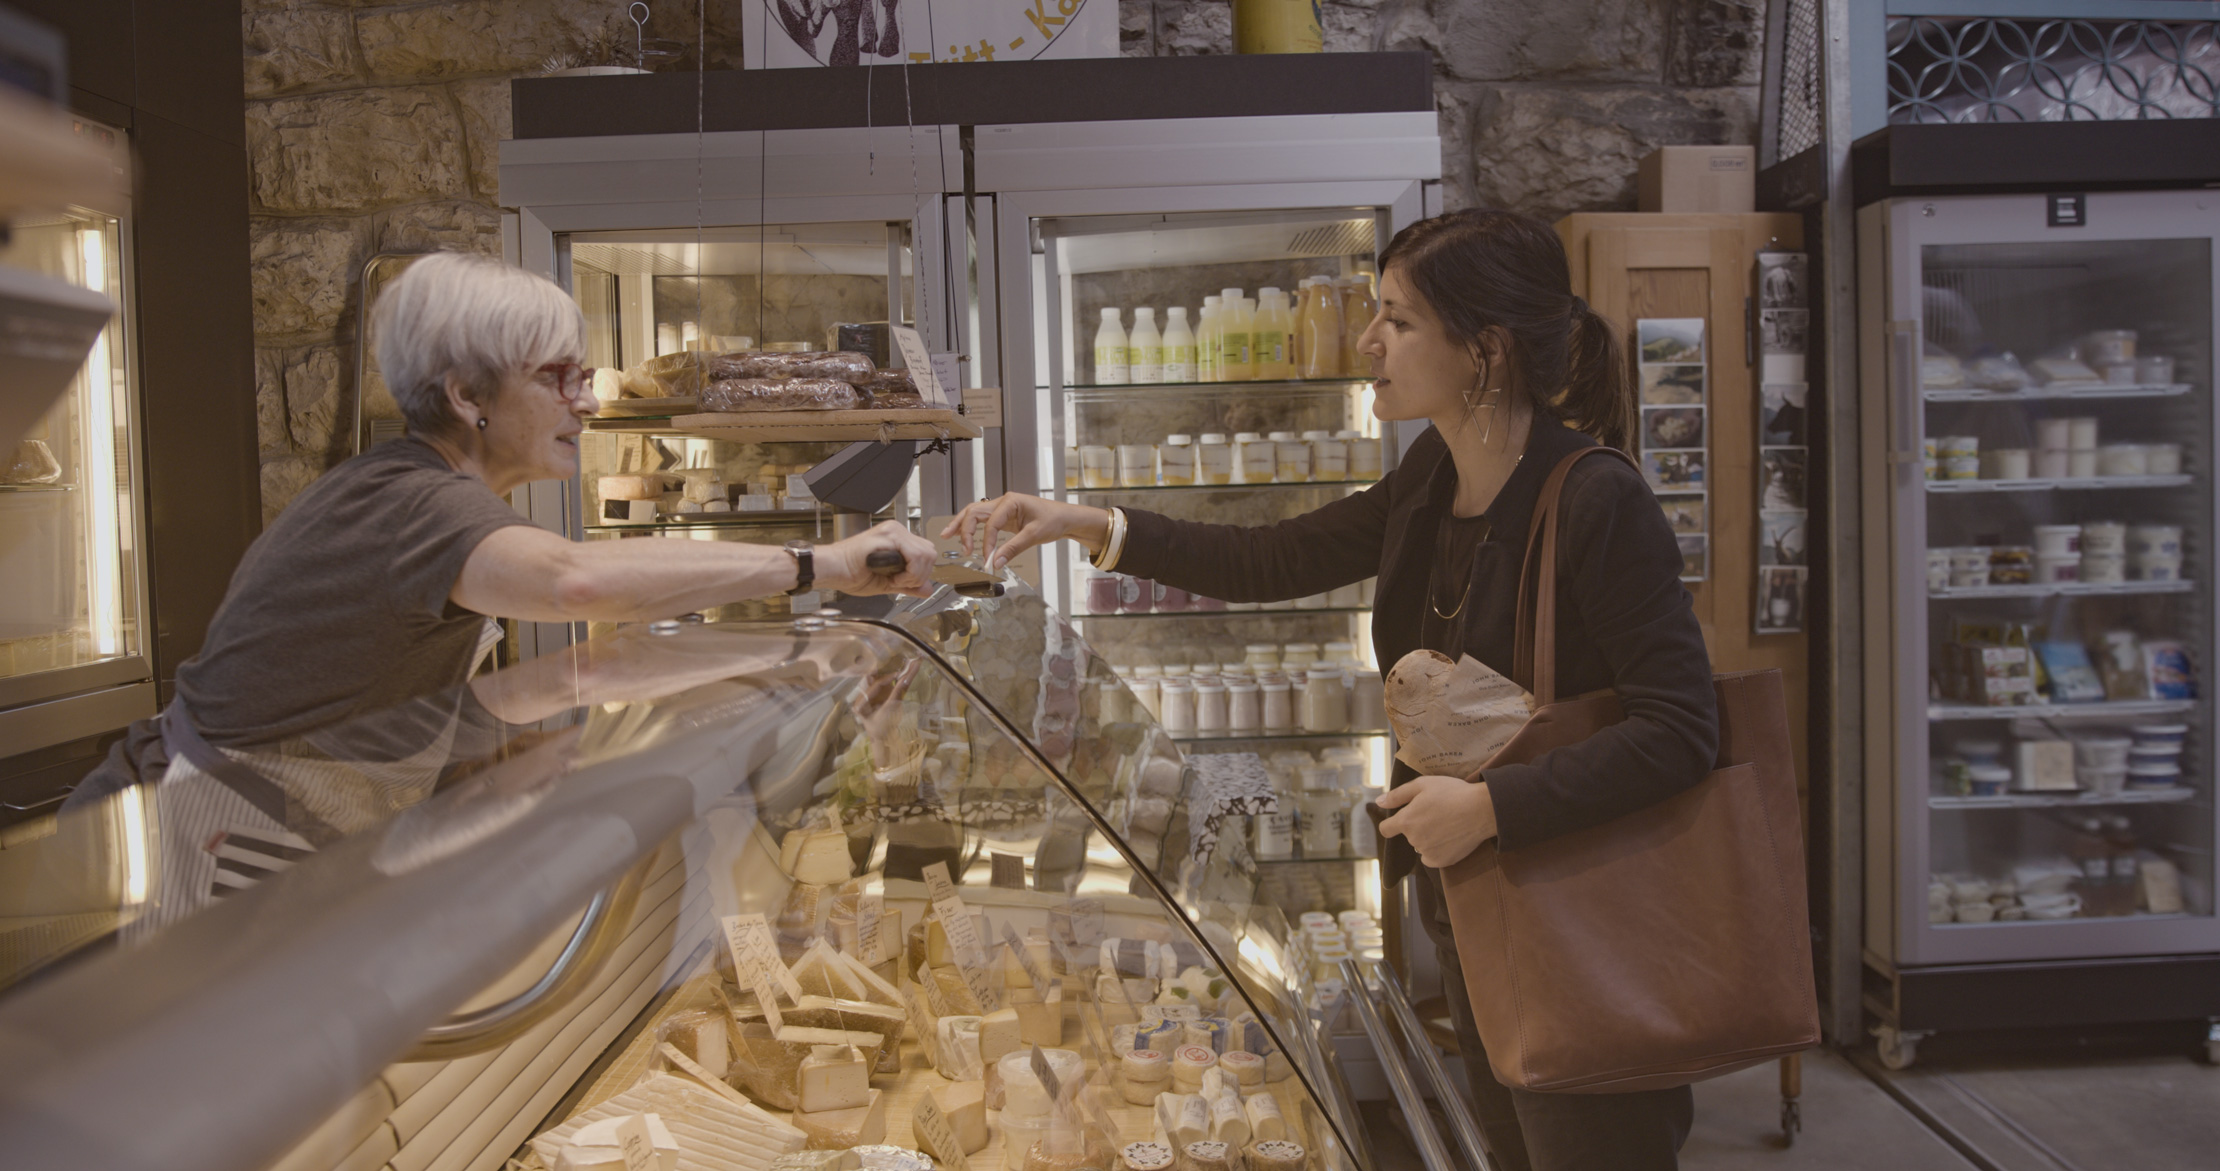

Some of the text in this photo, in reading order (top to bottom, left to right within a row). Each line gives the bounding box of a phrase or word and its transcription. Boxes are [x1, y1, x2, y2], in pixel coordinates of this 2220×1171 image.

[908, 39, 996, 64] Ttt
[1472, 675, 1490, 685] JOHN
[1473, 714, 1491, 724] JOHN
[1487, 742, 1505, 753] JOHN
[1419, 754, 1437, 764] JOHN
